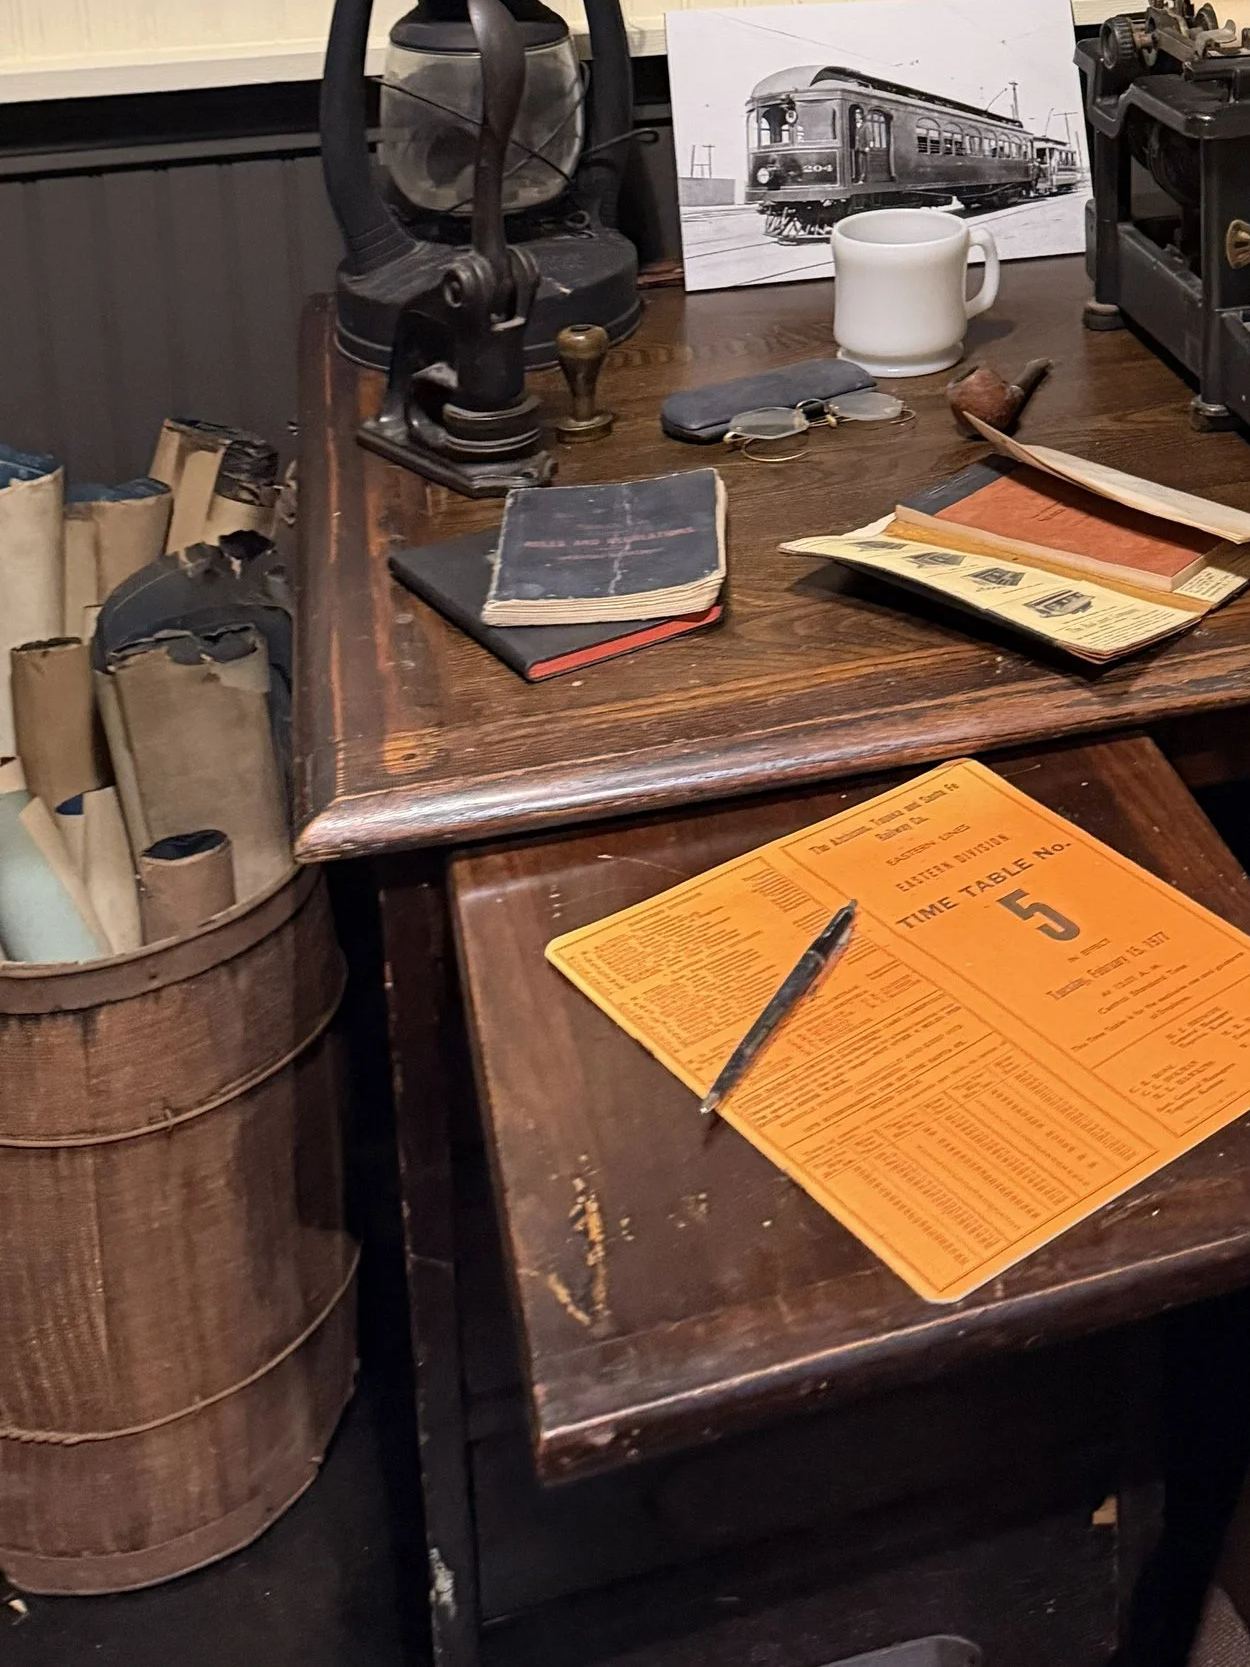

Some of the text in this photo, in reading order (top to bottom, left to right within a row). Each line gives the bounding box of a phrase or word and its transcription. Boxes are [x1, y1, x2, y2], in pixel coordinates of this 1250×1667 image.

[802, 163, 833, 174] 204
[918, 787, 947, 803] Santa
[943, 781, 959, 790] Fe
[885, 823, 970, 866] EASTERN LINES
[895, 832, 1011, 891] EASTERN DIVISION
[895, 837, 1072, 930] TIME TABLE No.
[998, 888, 1081, 942] 5
[1086, 954, 1129, 978] February
[1141, 932, 1170, 948] 1977
